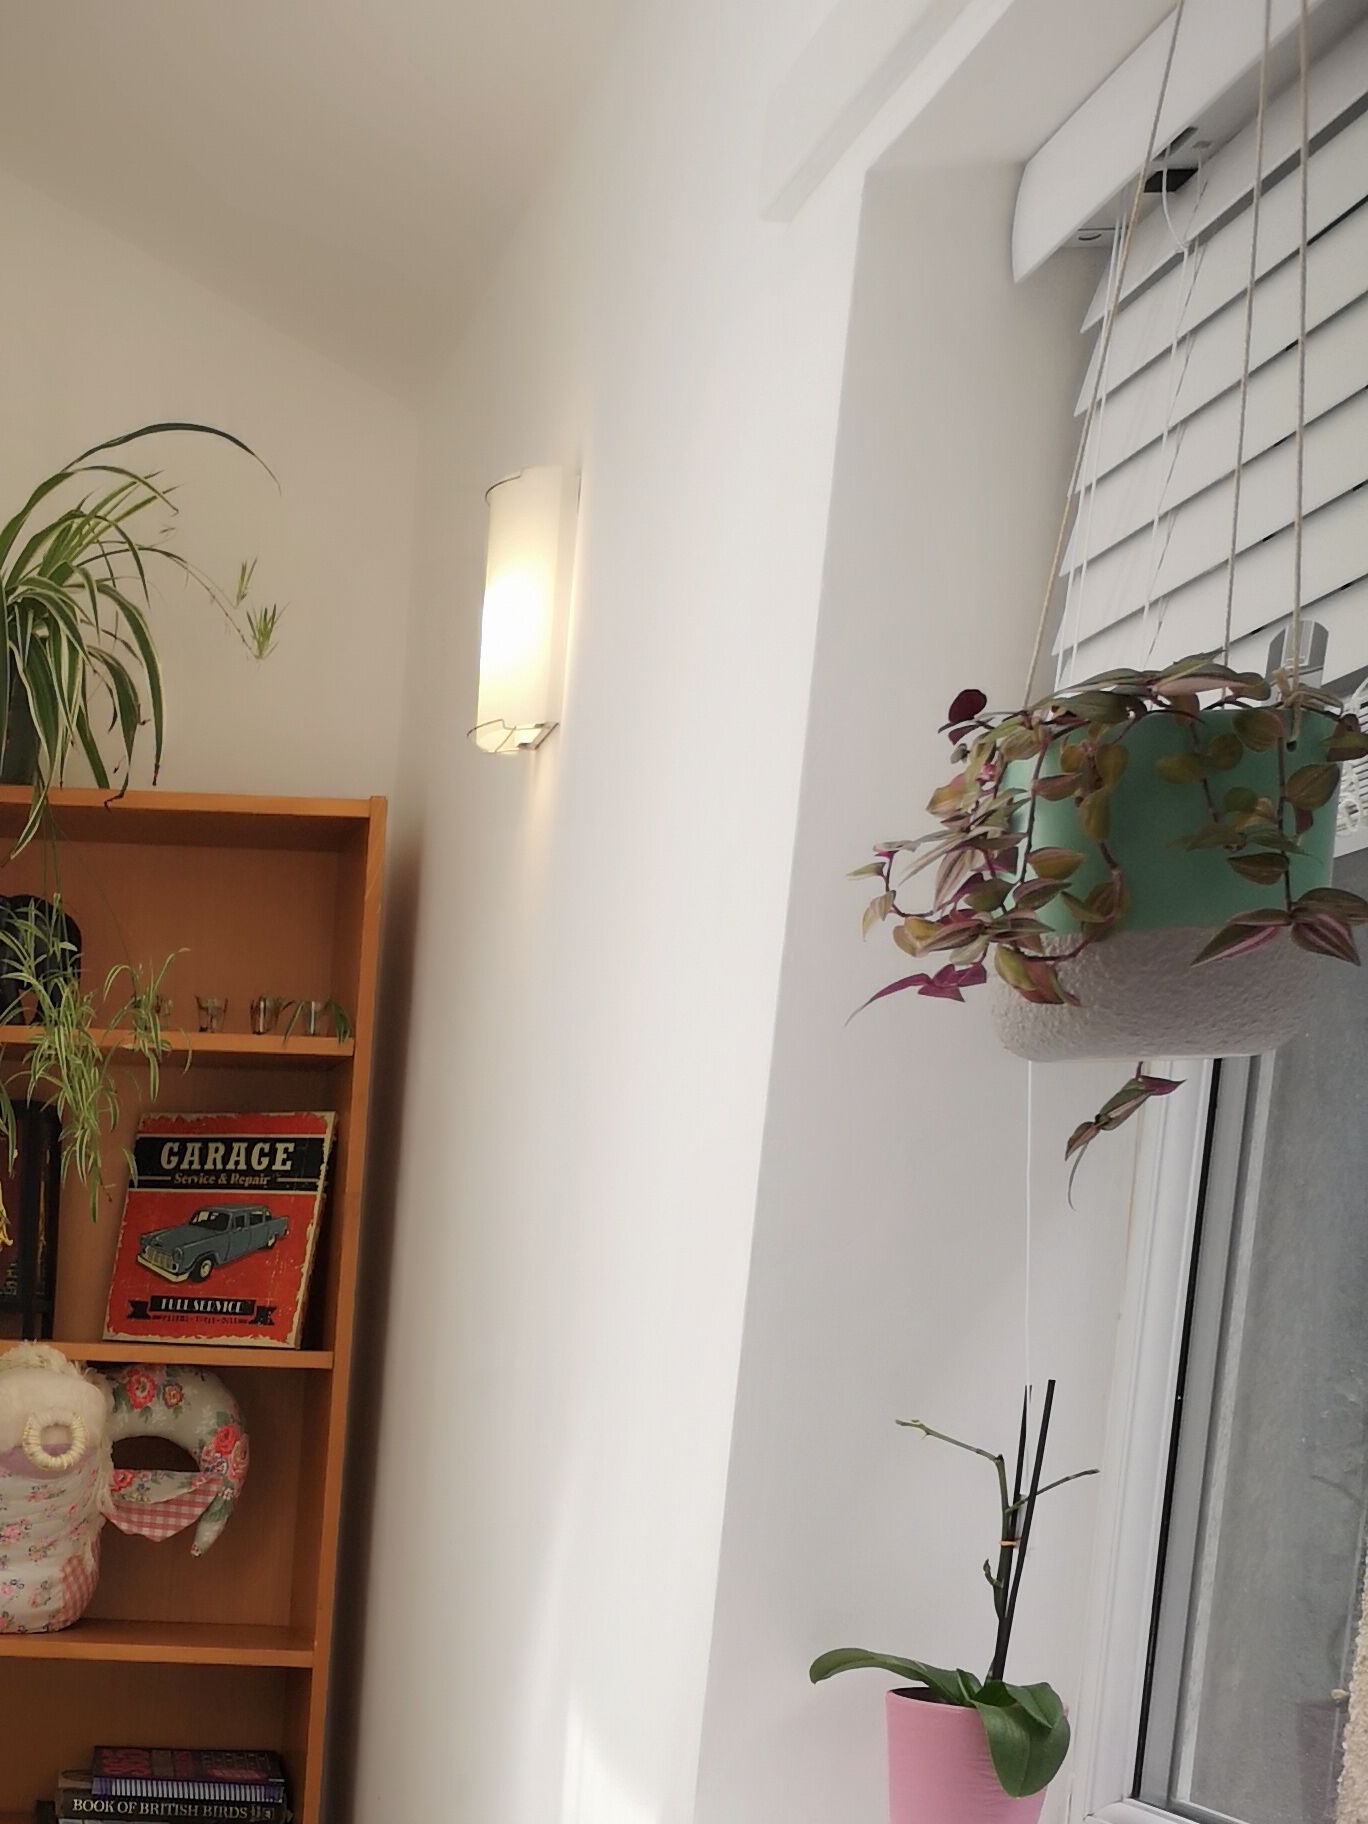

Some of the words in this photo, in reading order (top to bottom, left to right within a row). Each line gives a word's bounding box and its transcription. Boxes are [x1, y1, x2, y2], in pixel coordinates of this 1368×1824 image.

[160, 1141, 295, 1170] GARAGE
[174, 1173, 216, 1185] Service
[218, 1174, 228, 1185] &
[230, 1174, 271, 1187] Repair
[161, 1298, 189, 1310] FULL
[193, 1299, 242, 1313] SERVICE
[72, 1798, 114, 1813] BOOK
[117, 1800, 136, 1813] OF
[139, 1801, 200, 1817] BRITISH
[204, 1803, 248, 1819] BIRDS
